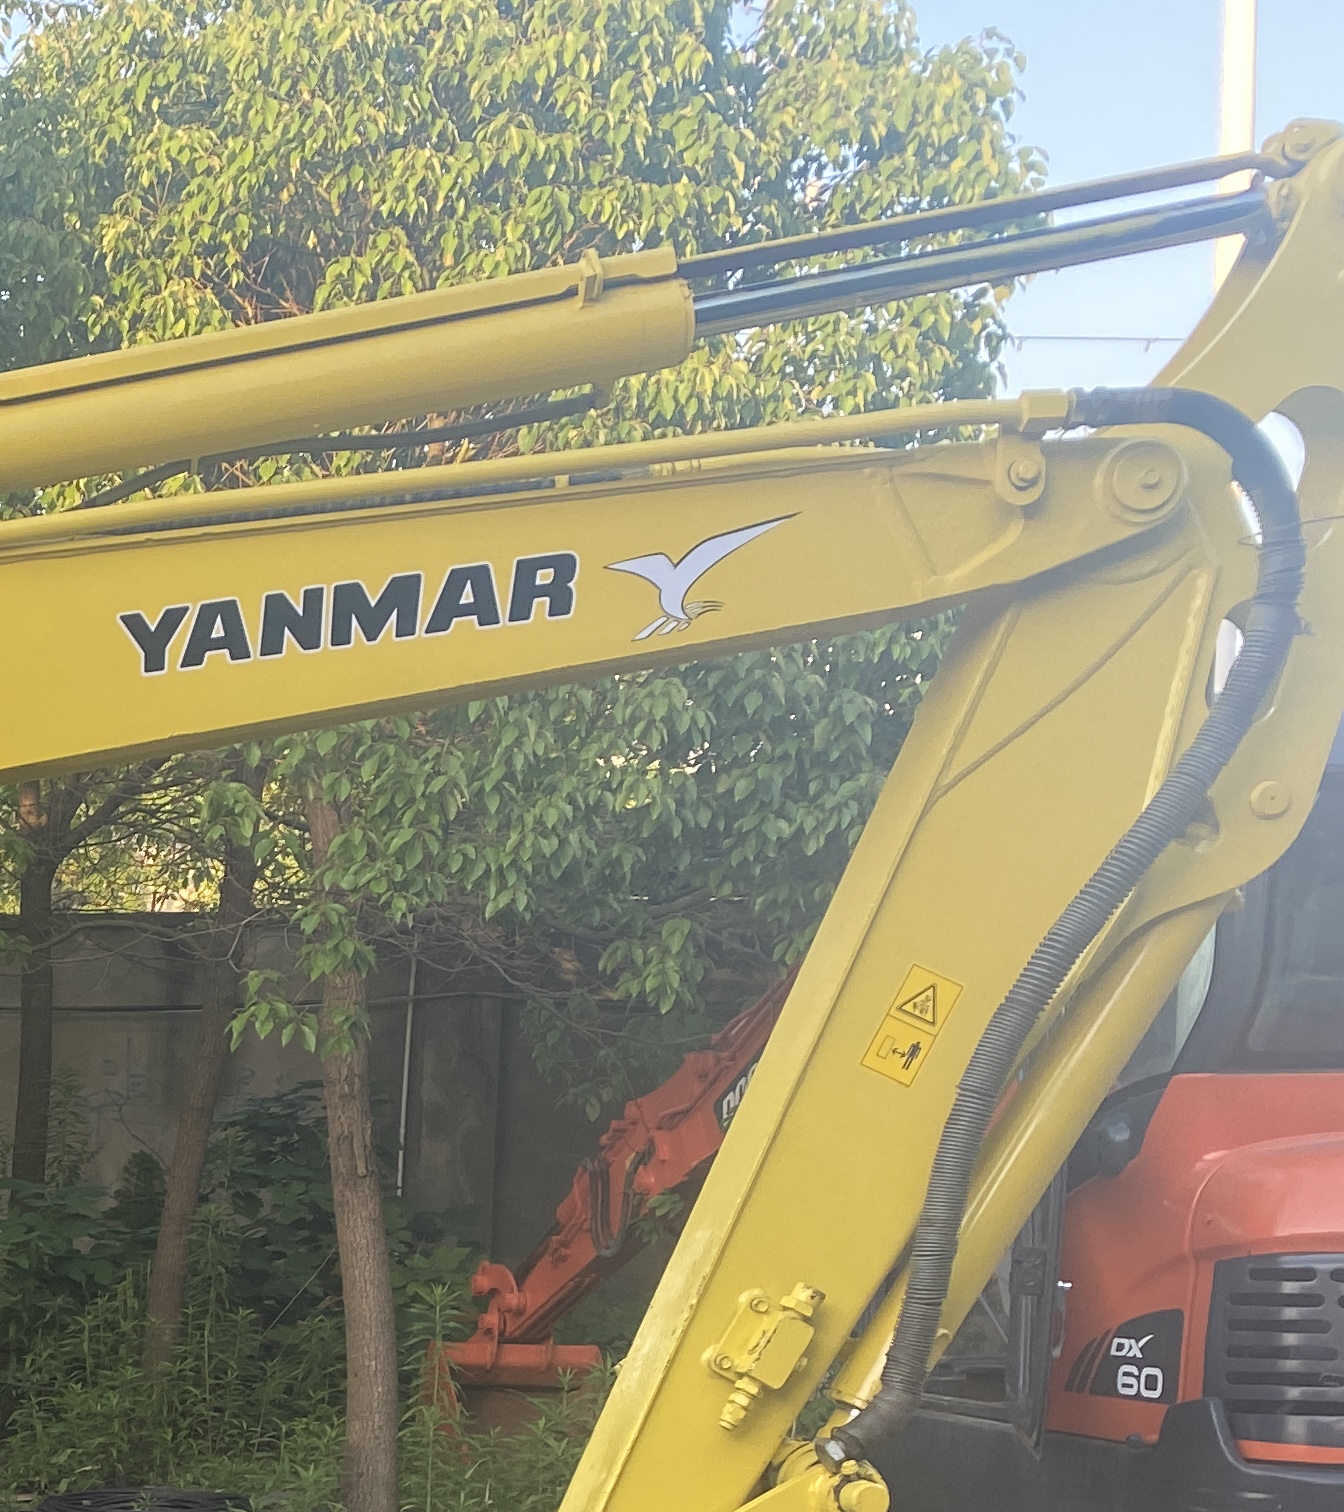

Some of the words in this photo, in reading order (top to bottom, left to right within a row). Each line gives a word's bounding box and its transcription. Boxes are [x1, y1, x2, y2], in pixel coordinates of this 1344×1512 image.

[118, 550, 579, 676] YANMAR
[1110, 1334, 1154, 1358] DX
[1117, 1364, 1163, 1398] 60
